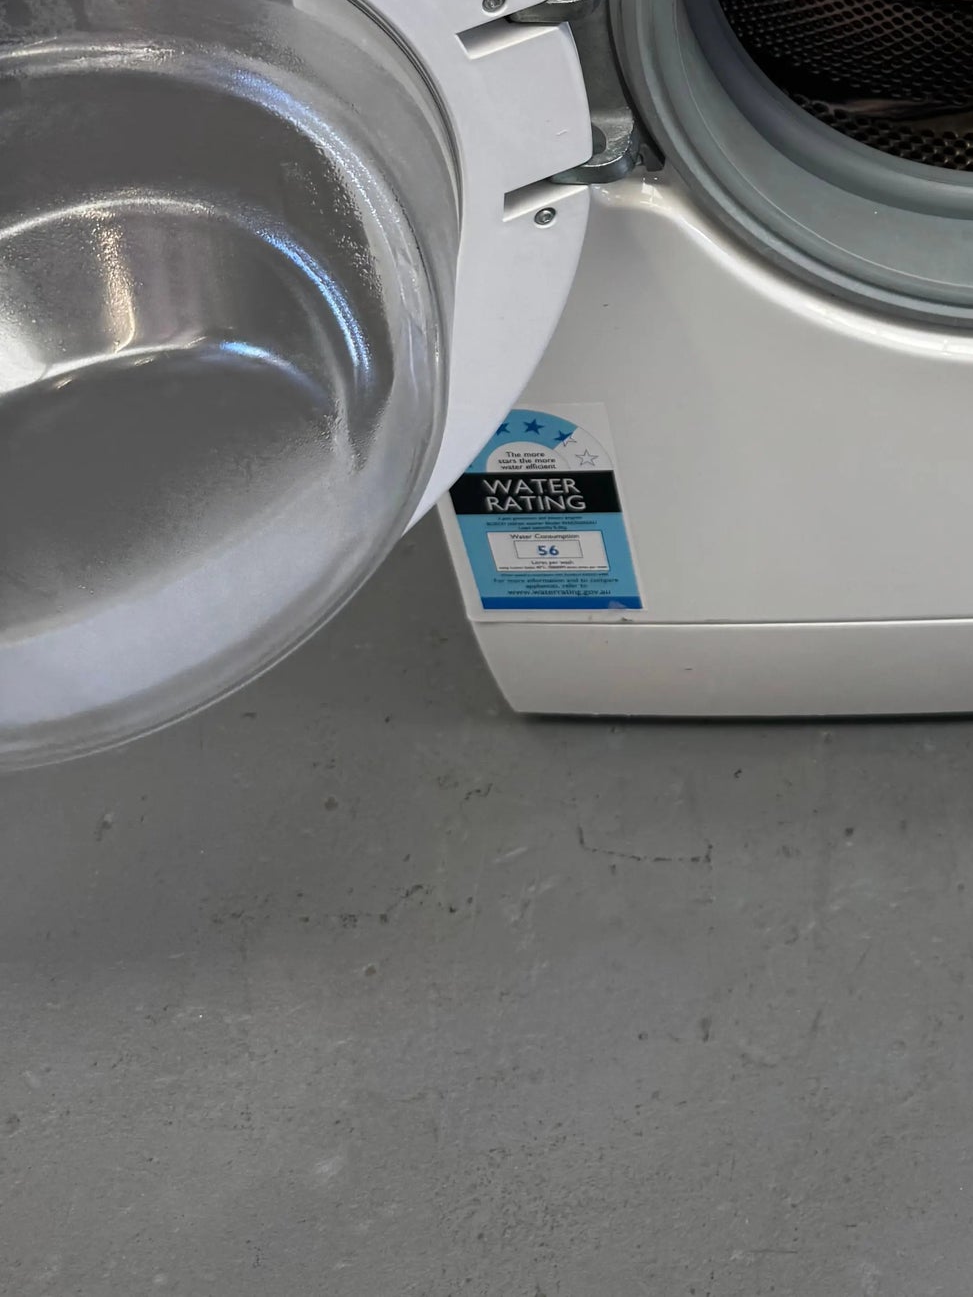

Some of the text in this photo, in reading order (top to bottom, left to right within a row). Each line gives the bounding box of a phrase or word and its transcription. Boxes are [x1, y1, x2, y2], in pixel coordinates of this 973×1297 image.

[483, 478, 581, 494] WATER
[486, 495, 587, 511] RATING
[538, 545, 559, 556] 56
